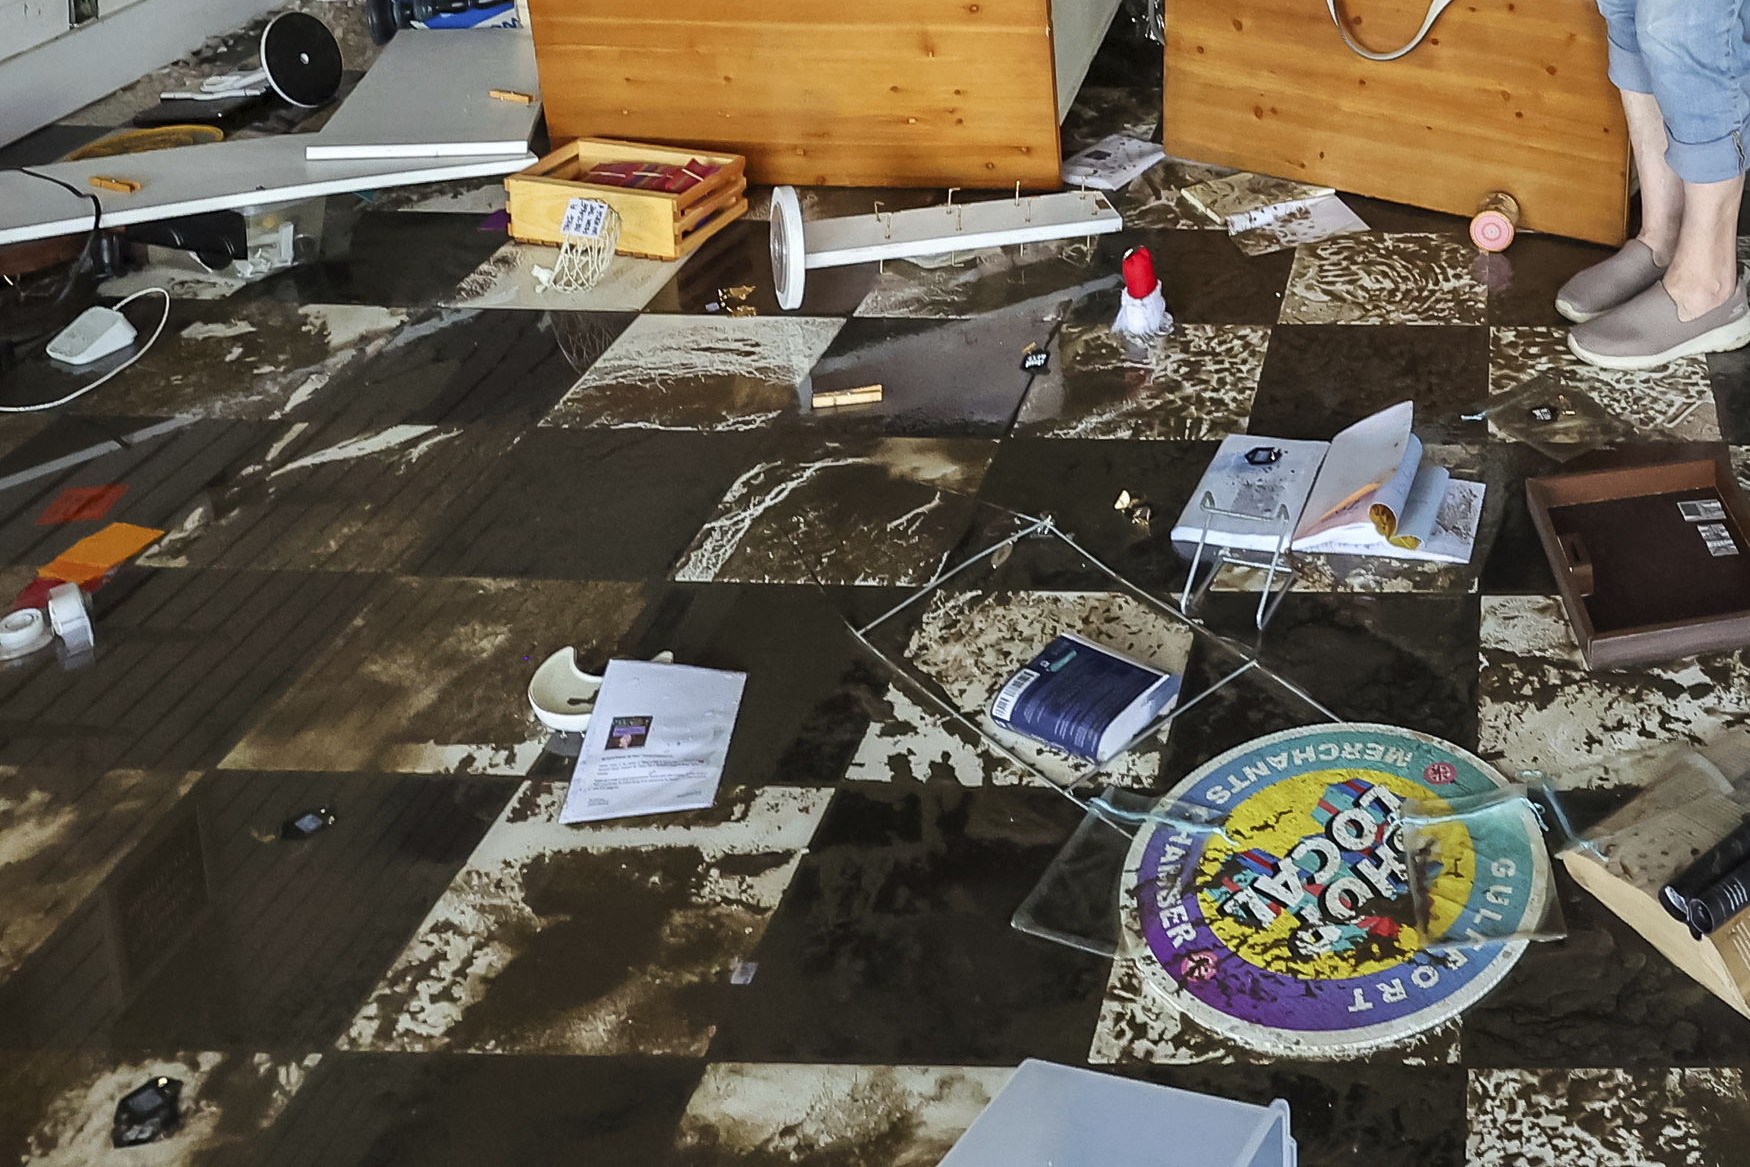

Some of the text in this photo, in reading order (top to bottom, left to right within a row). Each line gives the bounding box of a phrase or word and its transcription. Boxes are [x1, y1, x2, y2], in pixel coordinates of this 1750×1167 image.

[1204, 740, 1415, 806] MERCHANTS
[1223, 784, 1408, 931] LOCAL
[1346, 856, 1518, 1014] GULFPORT
